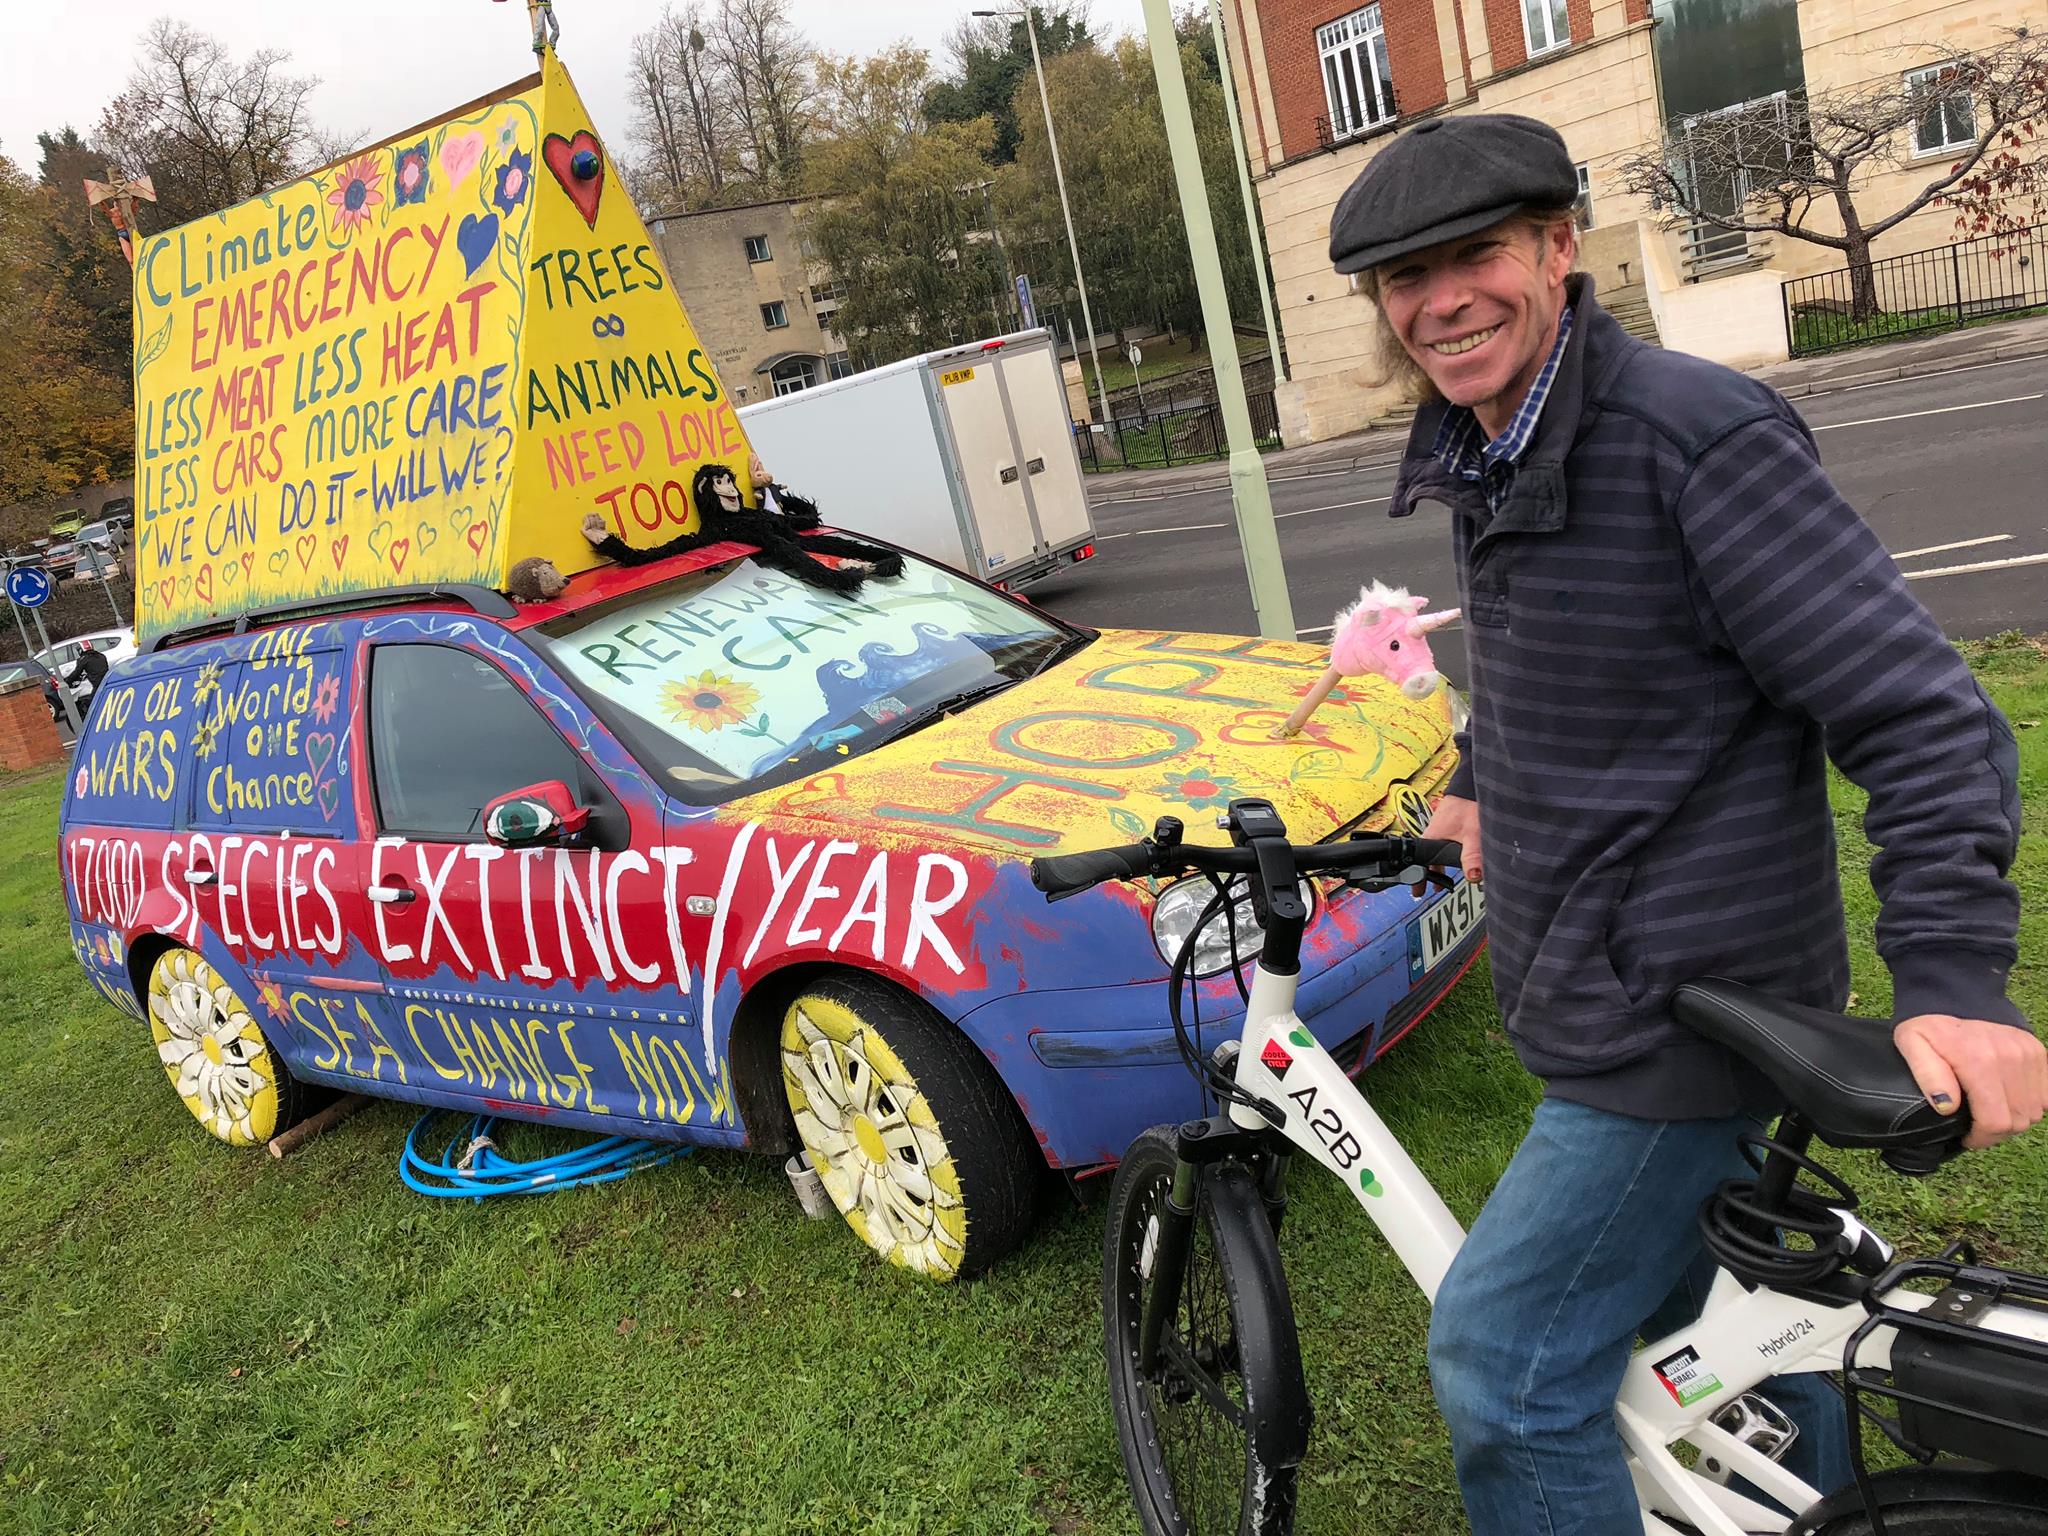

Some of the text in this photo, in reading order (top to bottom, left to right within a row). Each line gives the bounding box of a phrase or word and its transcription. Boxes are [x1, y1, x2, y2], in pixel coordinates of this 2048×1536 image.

[530, 244, 663, 309] TREES
[144, 281, 498, 460] LESS MEAT LESS HEAT
[528, 349, 718, 430] ANIMALS
[144, 363, 508, 521] LESS CARS MORE CARE
[544, 400, 741, 491] NEED LOVE
[155, 516, 195, 568] WE
[205, 491, 257, 556] CAN
[279, 481, 316, 534] DO
[595, 480, 689, 541] TOO
[249, 623, 328, 671] ONE
[580, 576, 800, 685] RENEWA
[723, 599, 890, 671] CAN
[96, 677, 182, 732] NO OIL
[216, 664, 313, 728] World
[91, 729, 176, 801] WARS
[869, 633, 1332, 848] HOPE
[207, 764, 314, 815] Chance
[1412, 957, 1423, 970] GB
[289, 991, 734, 1127] SEA CHANGE NOW
[1287, 1086, 1361, 1169] A2B
[1662, 1354, 1692, 1376] BOYCOTT
[1757, 1318, 1815, 1359] Hybrid/24
[1672, 1369, 1697, 1386] ISRAELI
